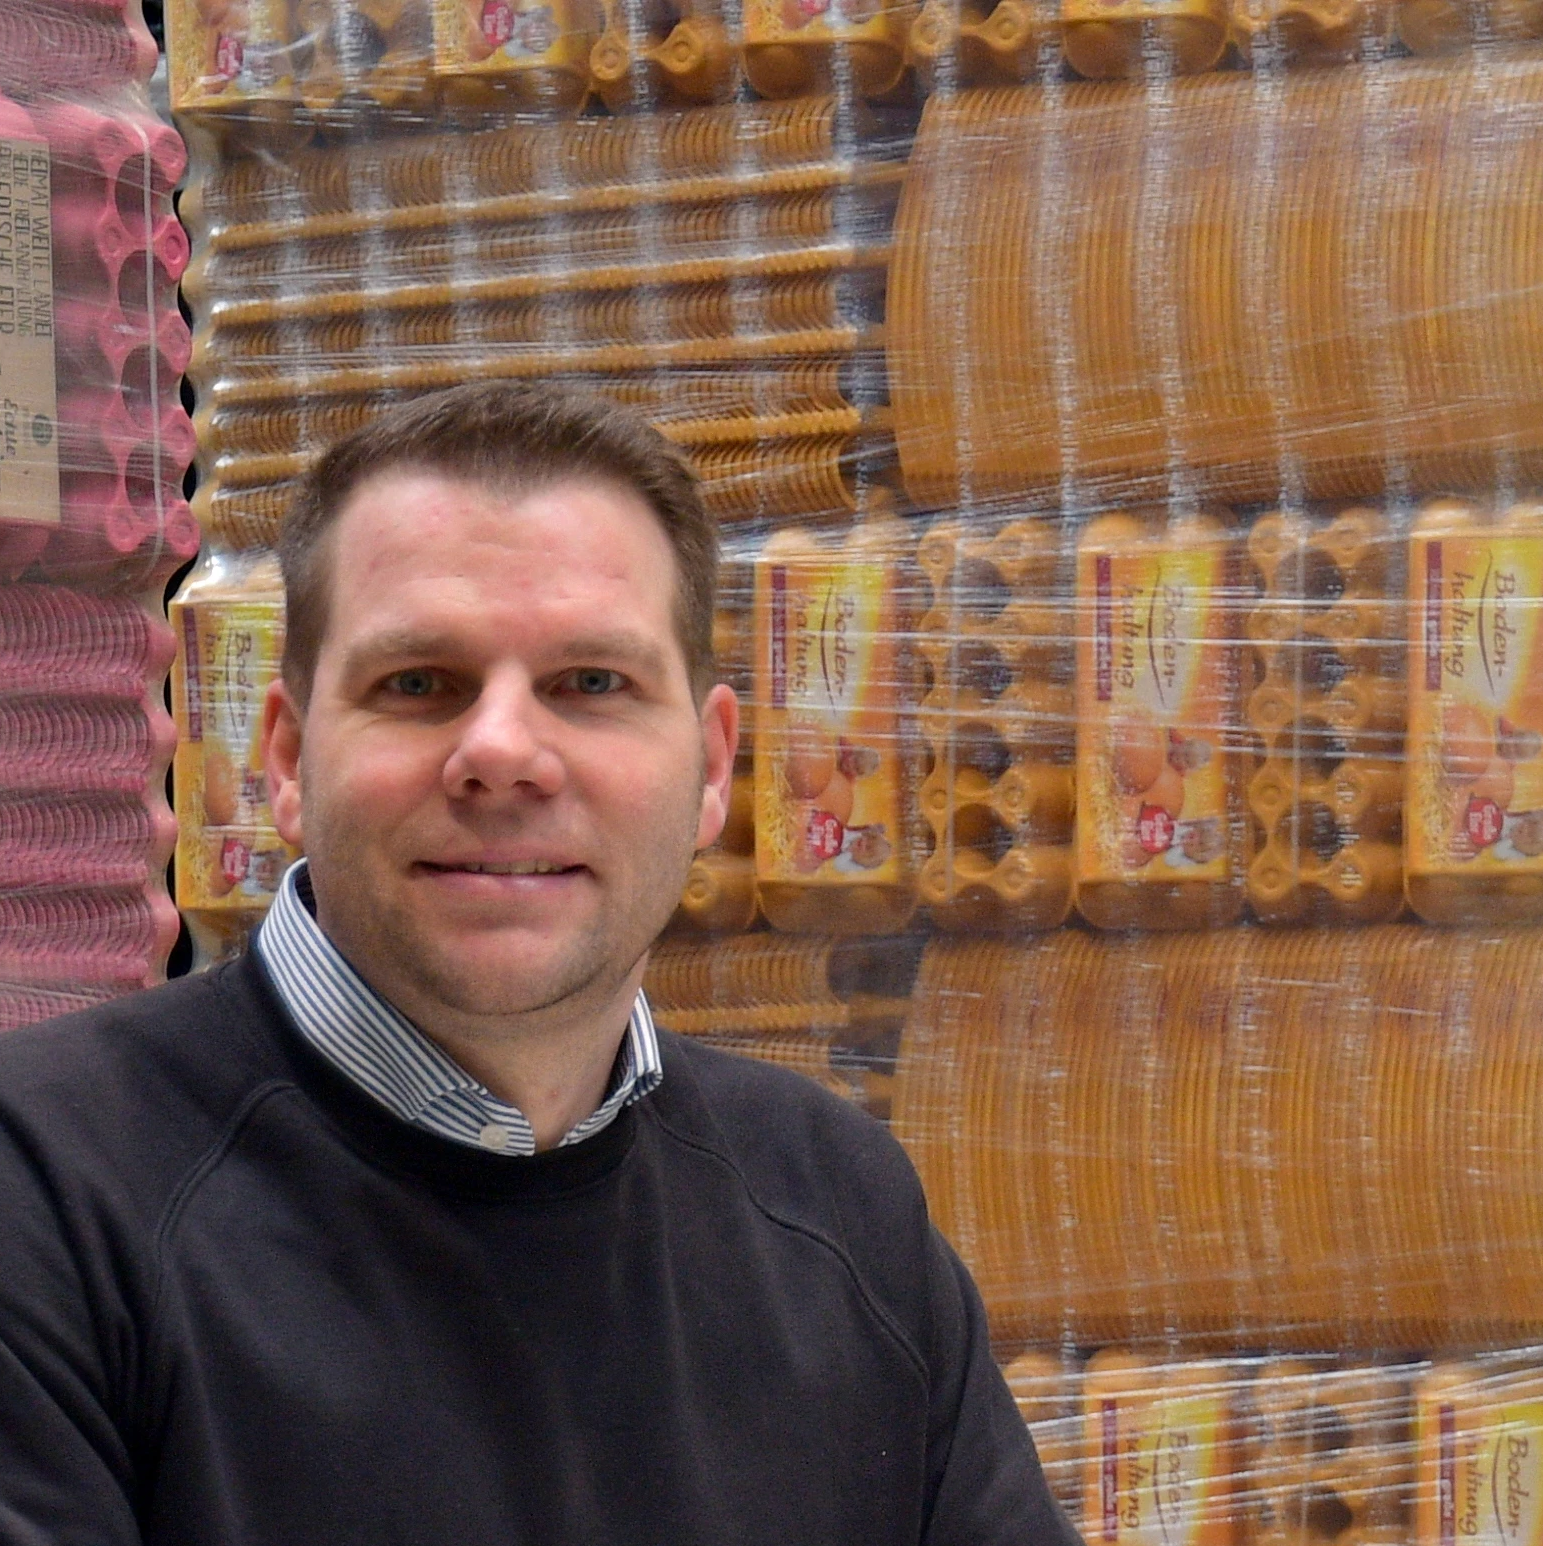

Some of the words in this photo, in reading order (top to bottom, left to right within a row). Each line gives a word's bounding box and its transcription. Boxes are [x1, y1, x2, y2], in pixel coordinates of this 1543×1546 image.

[2, 398, 17, 454] Echte
[1447, 570, 1474, 678] haltung
[1493, 572, 1516, 677] Boden-
[1505, 1435, 1528, 1539] Boden-
